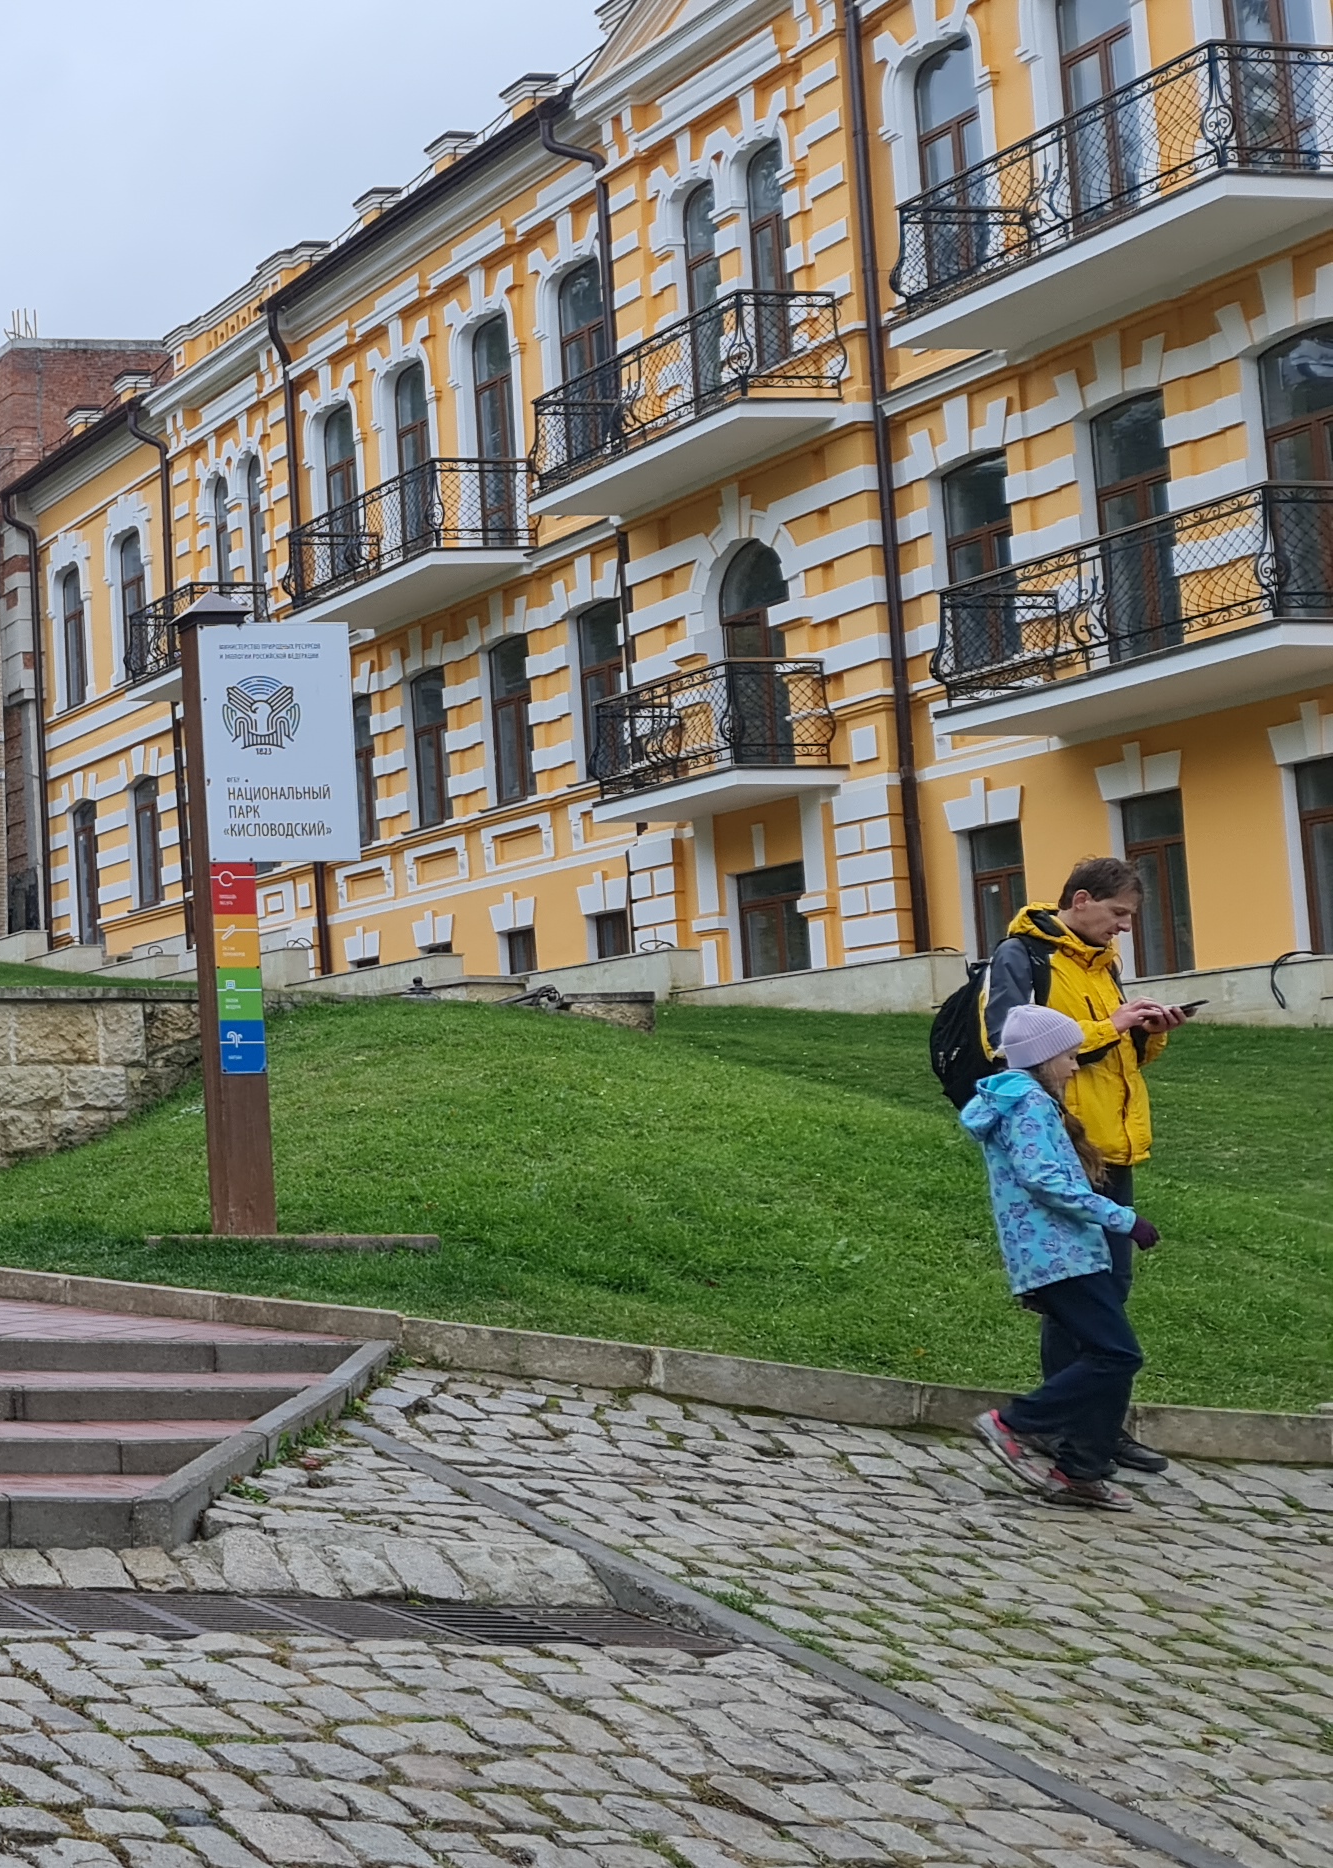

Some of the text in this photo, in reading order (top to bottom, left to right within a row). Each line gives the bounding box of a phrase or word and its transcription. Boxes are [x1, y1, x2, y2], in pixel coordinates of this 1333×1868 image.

[256, 747, 272, 756] 1823
[227, 784, 331, 803] НАЦИОНАЛЬНЫЙ
[228, 804, 261, 819] ПАРК
[223, 820, 333, 839] «КИСЛОВОДСКИЙ»
